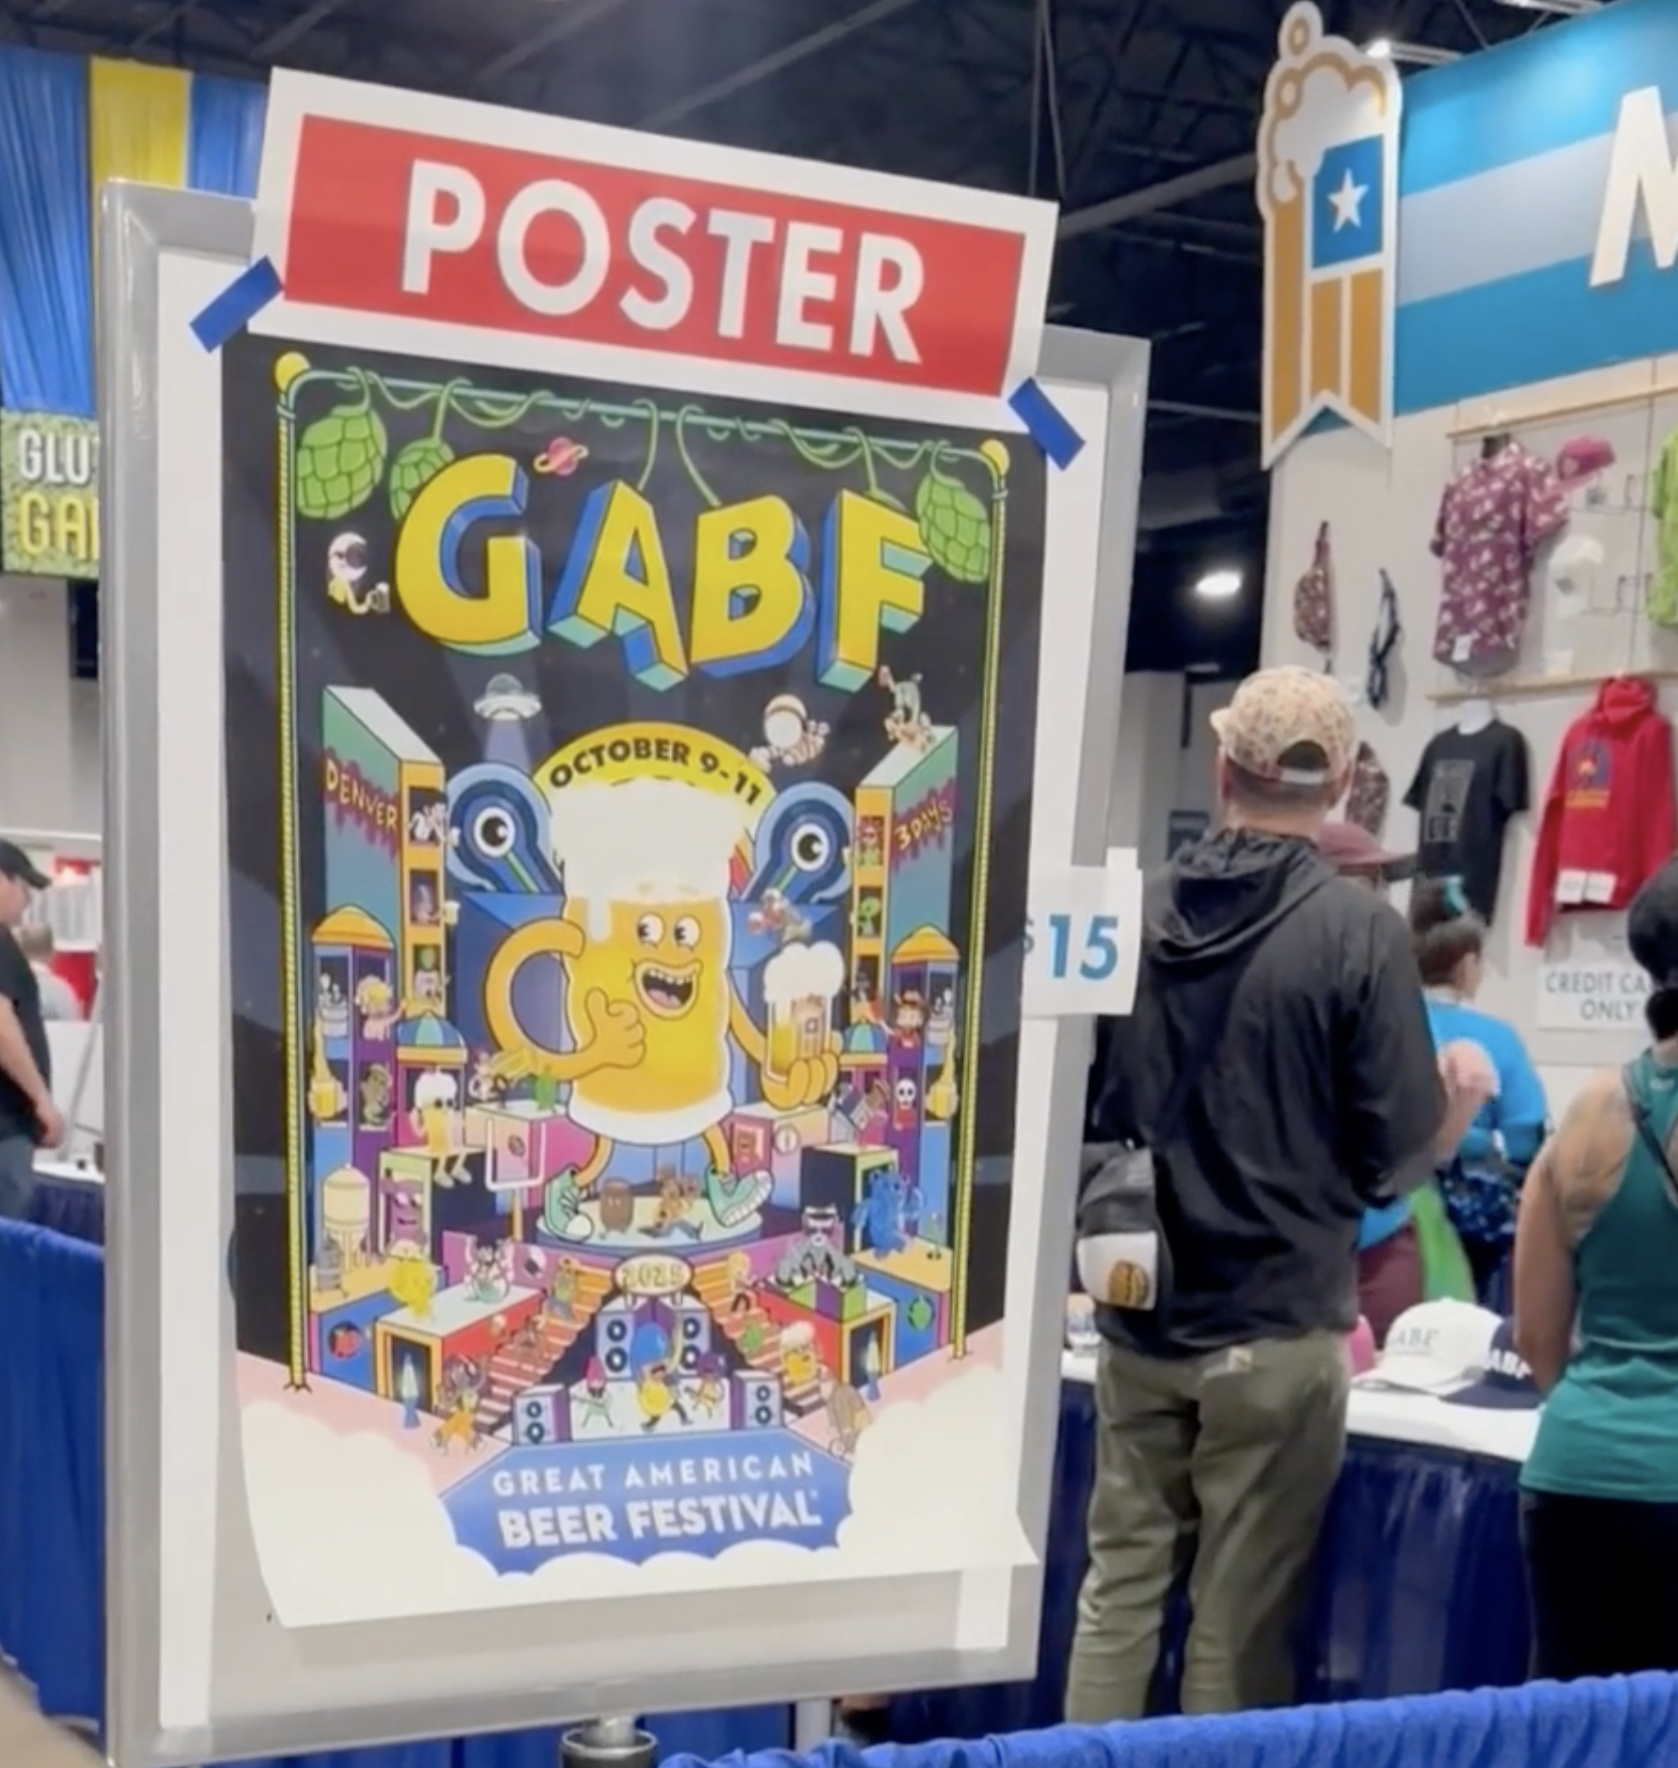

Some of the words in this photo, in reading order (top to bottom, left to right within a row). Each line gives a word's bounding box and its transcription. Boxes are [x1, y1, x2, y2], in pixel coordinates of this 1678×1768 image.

[402, 159, 924, 365] POSTER
[19, 428, 99, 485] GLU
[395, 453, 934, 692] GABF
[326, 759, 398, 832] DENVER
[549, 737, 690, 788] OCTOBER
[699, 751, 762, 806] 9-11
[1546, 971, 1613, 994] CREDIT
[1619, 971, 1652, 994] CA
[1580, 999, 1636, 1021] ONLY
[493, 1464, 604, 1497] GREAT
[624, 1451, 814, 1489] AMERICAN
[498, 1504, 617, 1548] BEER
[626, 1490, 822, 1539] FESTIVAL
